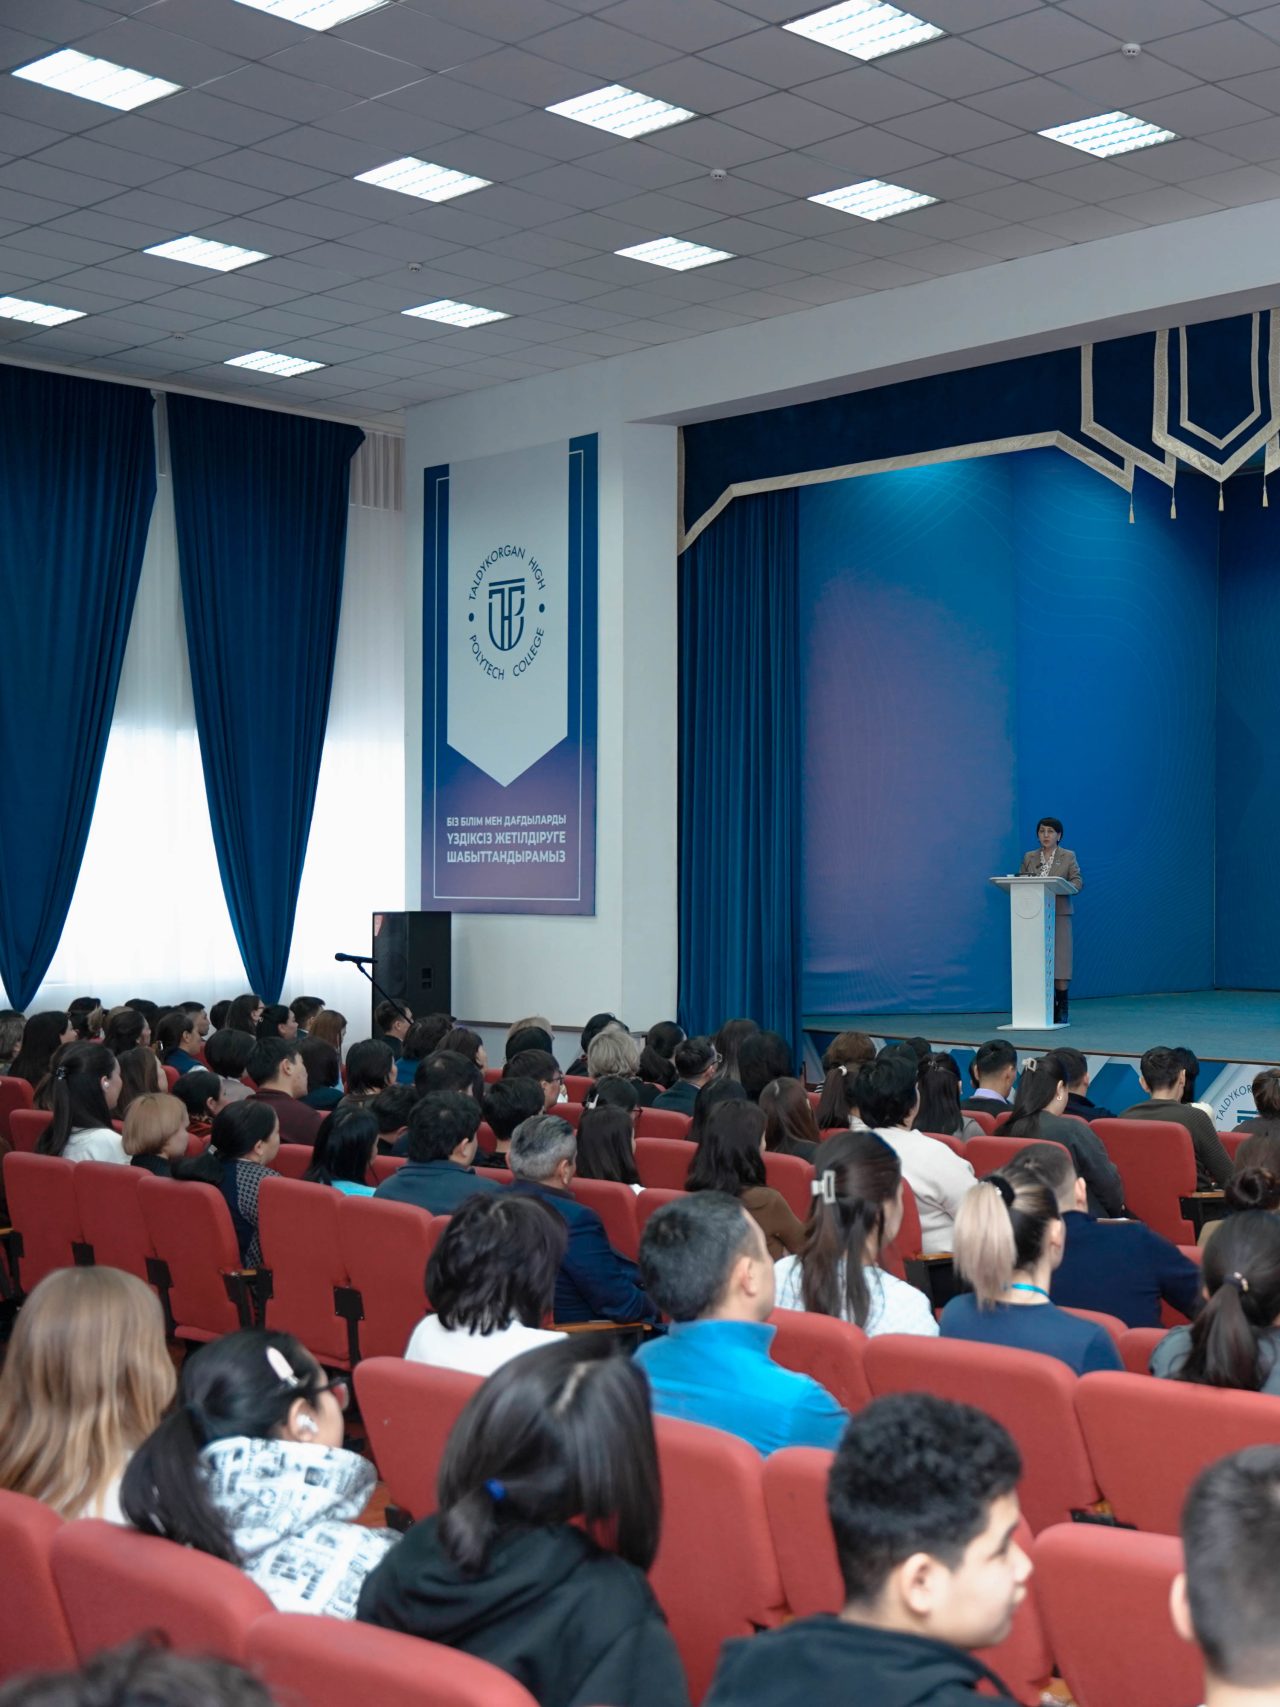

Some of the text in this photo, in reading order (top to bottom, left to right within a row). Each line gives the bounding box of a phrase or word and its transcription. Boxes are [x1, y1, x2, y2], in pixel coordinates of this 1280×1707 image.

[469, 545, 546, 601] TALDYKORGAN HIGH
[469, 627, 544, 680] POLYTECH COLLEGE
[485, 815, 502, 826] МЕН
[447, 850, 566, 865] ШАБЫТТАНДЫРАМЫЗ
[1216, 1084, 1253, 1121] TALDYKOR
